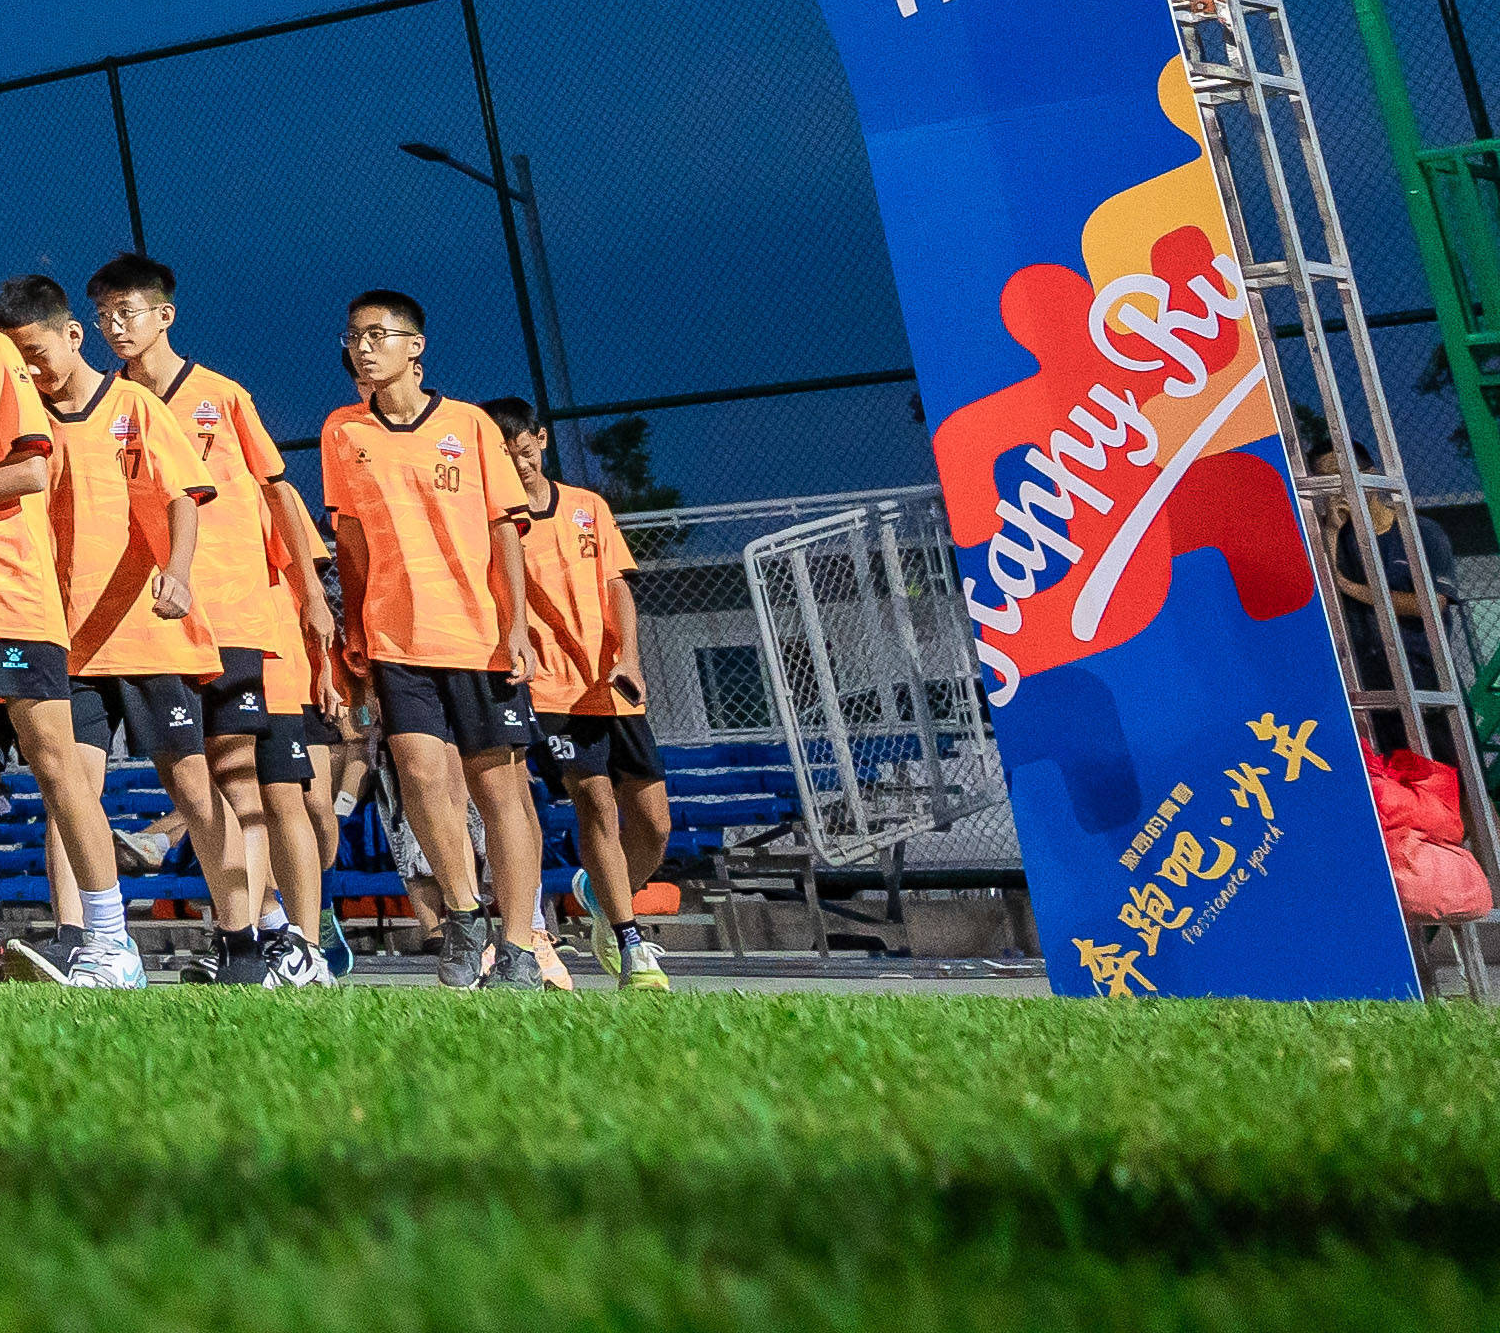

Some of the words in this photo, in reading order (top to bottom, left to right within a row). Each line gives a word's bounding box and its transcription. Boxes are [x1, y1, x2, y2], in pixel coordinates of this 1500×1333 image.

[198, 433, 215, 462] 7
[115, 447, 141, 481] 17
[434, 463, 460, 493] 30
[578, 533, 599, 559] 25
[1, 661, 28, 669] KELME
[547, 734, 576, 760] 25
[1181, 868, 1251, 945] Passionate
[1247, 821, 1285, 877] youth
